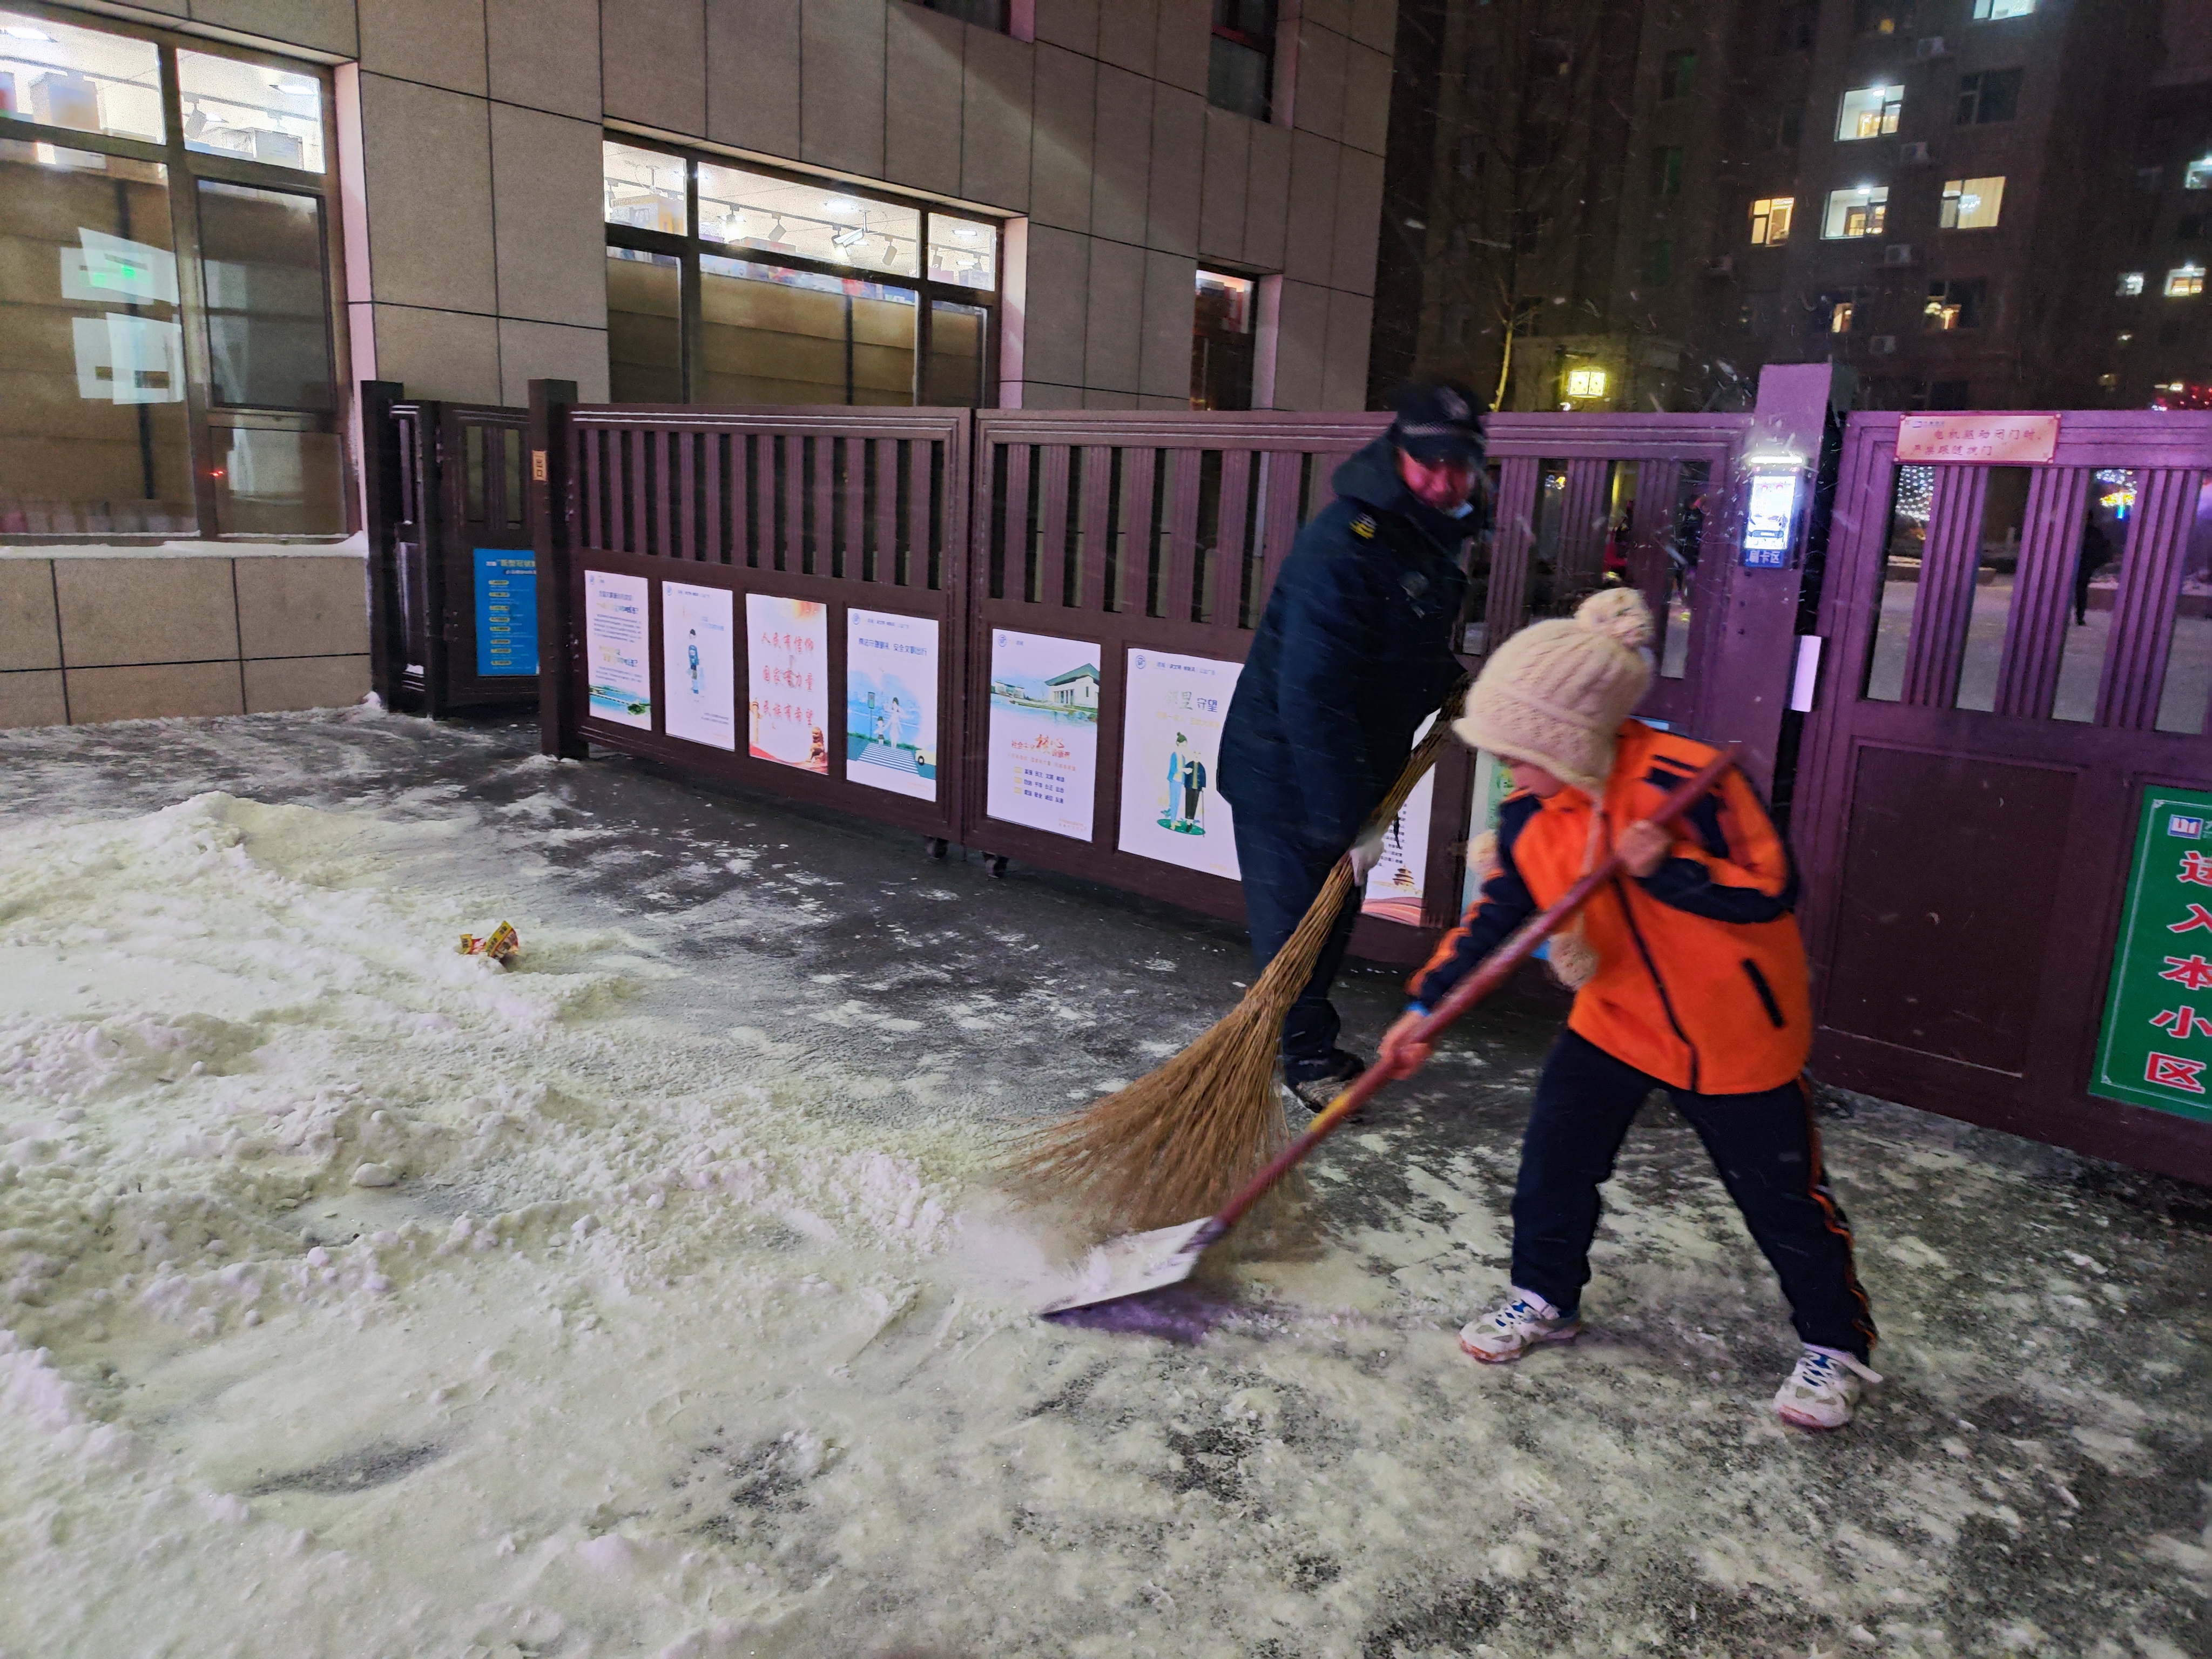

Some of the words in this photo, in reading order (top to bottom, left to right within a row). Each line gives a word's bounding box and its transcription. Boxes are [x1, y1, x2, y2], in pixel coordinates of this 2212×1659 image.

[1749, 549, 1781, 564] 刷卡区
[761, 632, 814, 655] 人民有信仰
